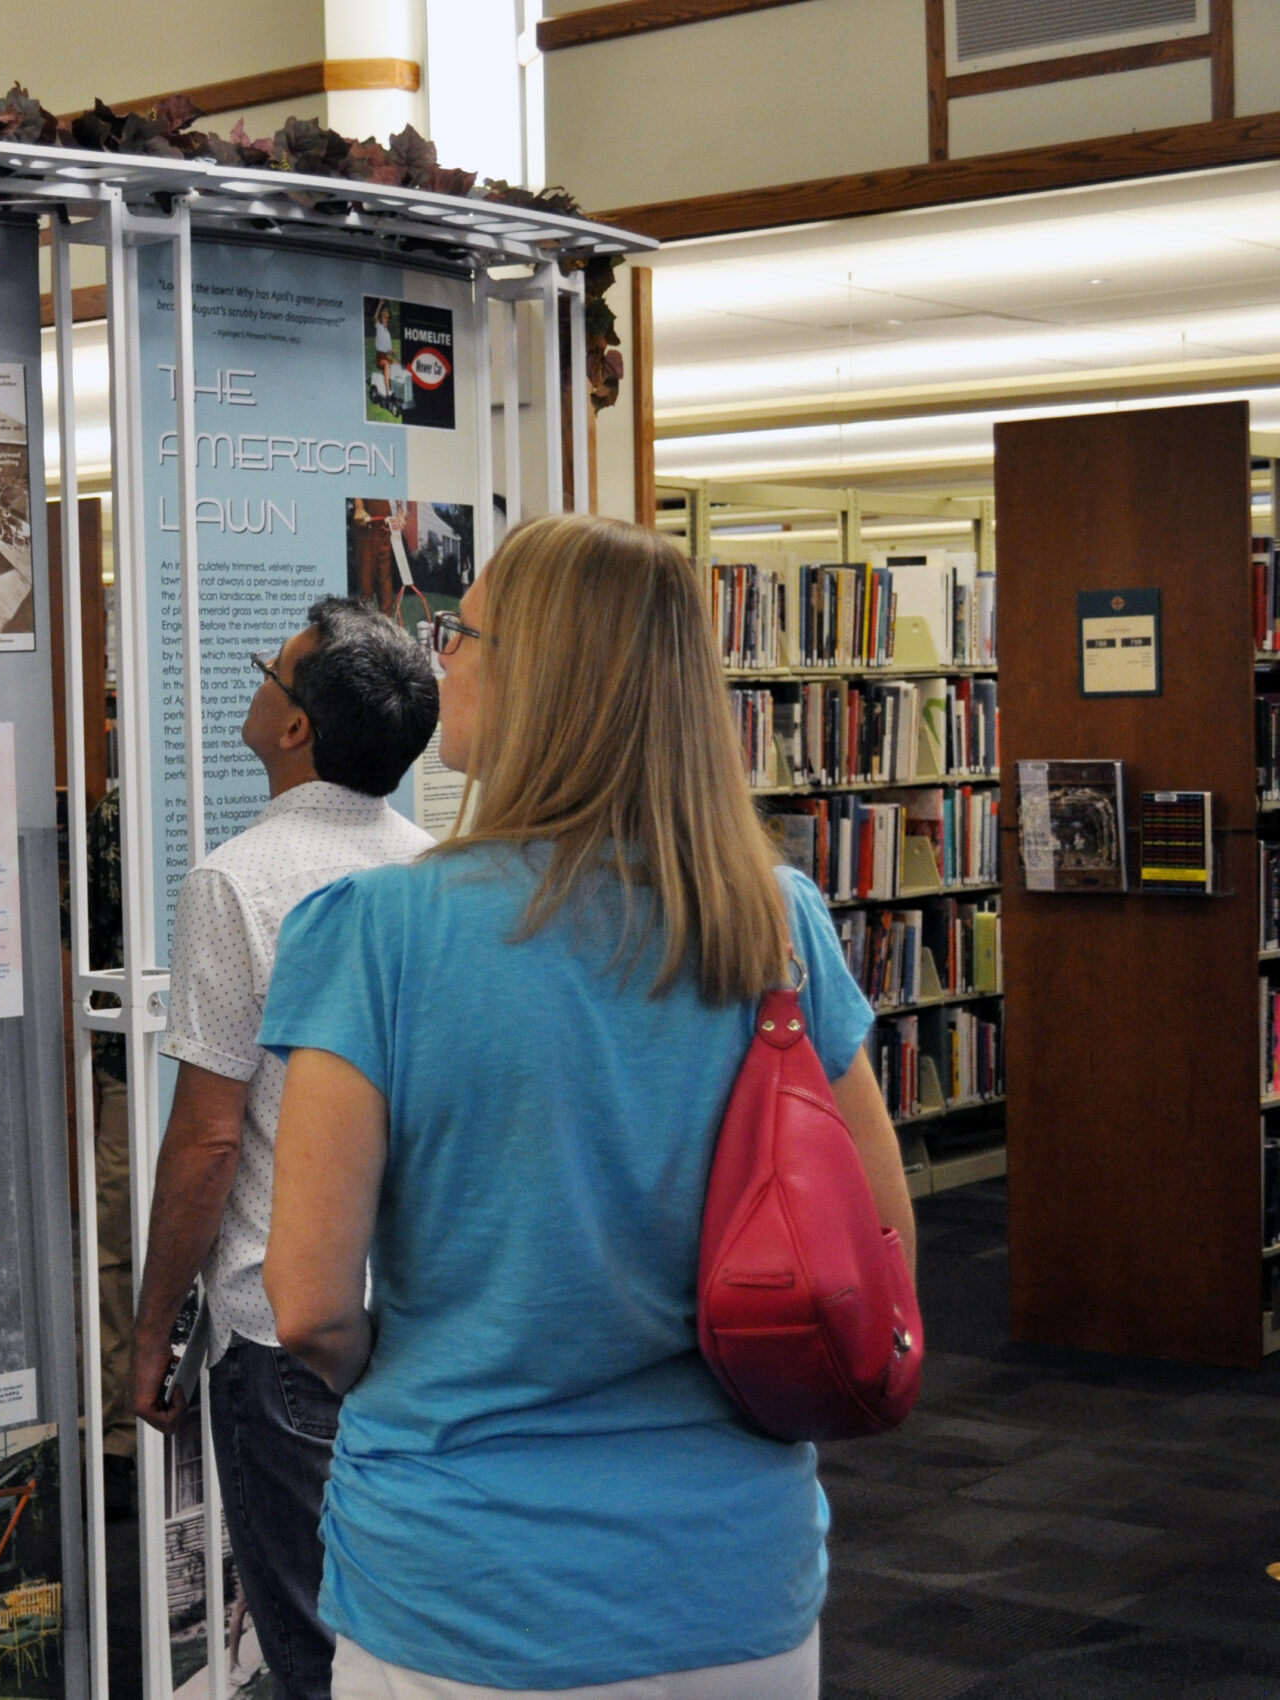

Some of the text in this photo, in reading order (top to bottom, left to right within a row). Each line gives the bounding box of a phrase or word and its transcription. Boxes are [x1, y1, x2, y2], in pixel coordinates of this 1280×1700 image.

[236, 287, 254, 300] Why
[228, 307, 258, 322] scrubby
[259, 310, 283, 321] brown
[404, 327, 451, 346] HOMELITE
[158, 495, 297, 535] LAWN
[161, 561, 316, 574] An trimmed, velvety green
[201, 577, 325, 589] not always a pervasive symbol of
[161, 591, 306, 603] the landscape. The idea of
[161, 606, 306, 618] of grass was an import
[201, 620, 301, 630] Before the invention of the
[216, 636, 260, 645] lawns were
[162, 650, 226, 662] by which
[213, 665, 251, 677] money to
[163, 680, 228, 689] In and
[163, 696, 172, 705] of
[220, 694, 237, 703] and
[164, 724, 226, 735] that stay
[231, 768, 244, 777] the
[164, 794, 258, 807] In a luxurious
[165, 813, 175, 823] of
[221, 826, 229, 835] to
[166, 844, 174, 853] in
[166, 858, 188, 867] Rows
